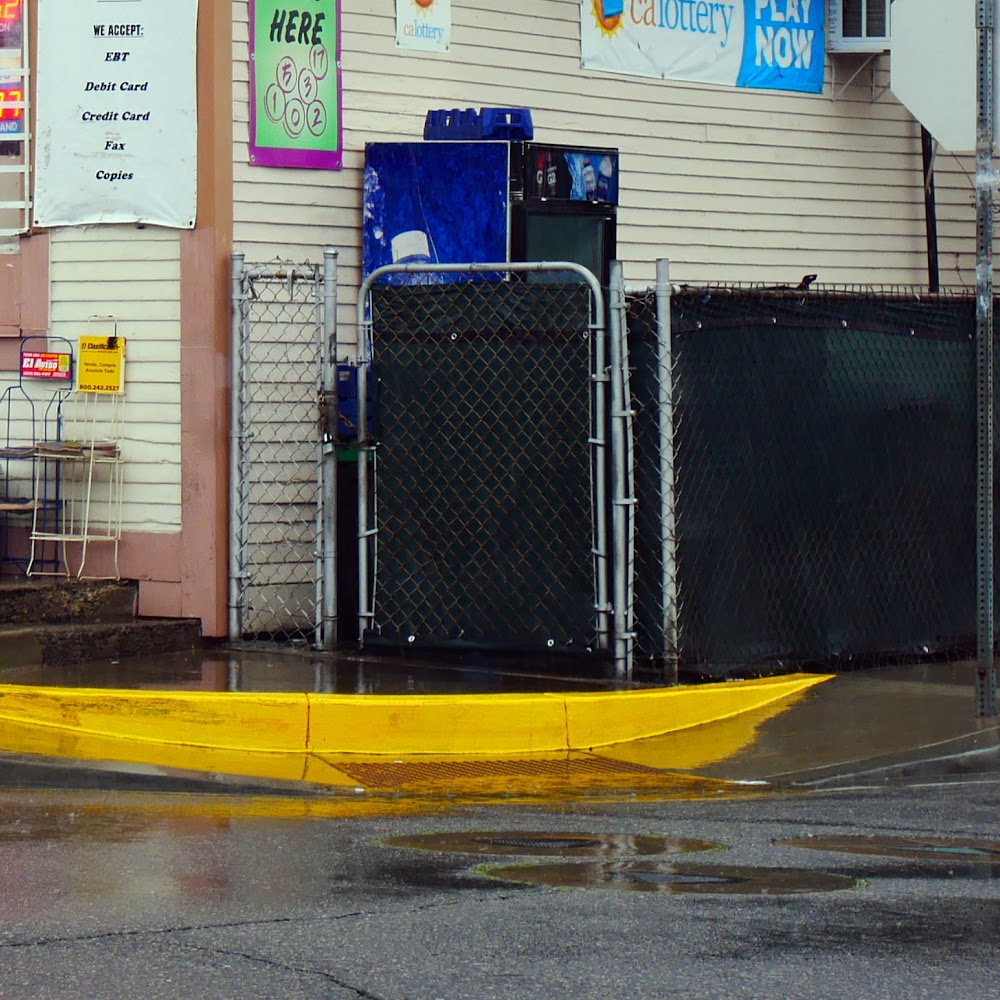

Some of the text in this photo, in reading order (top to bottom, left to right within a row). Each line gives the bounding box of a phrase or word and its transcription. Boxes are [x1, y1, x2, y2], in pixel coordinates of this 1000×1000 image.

[93, 24, 144, 36] WE ACCEPT:
[269, 8, 326, 46] HERE
[403, 19, 444, 44] calottery
[754, 25, 815, 70] NOW
[104, 52, 130, 62] EBT
[313, 49, 325, 69] 17
[84, 81, 149, 92] Debit Card
[304, 76, 312, 98] 3
[81, 111, 151, 121] Credit Card
[312, 108, 323, 128] 2
[104, 140, 126, 151] Fax
[95, 170, 134, 182] Copies
